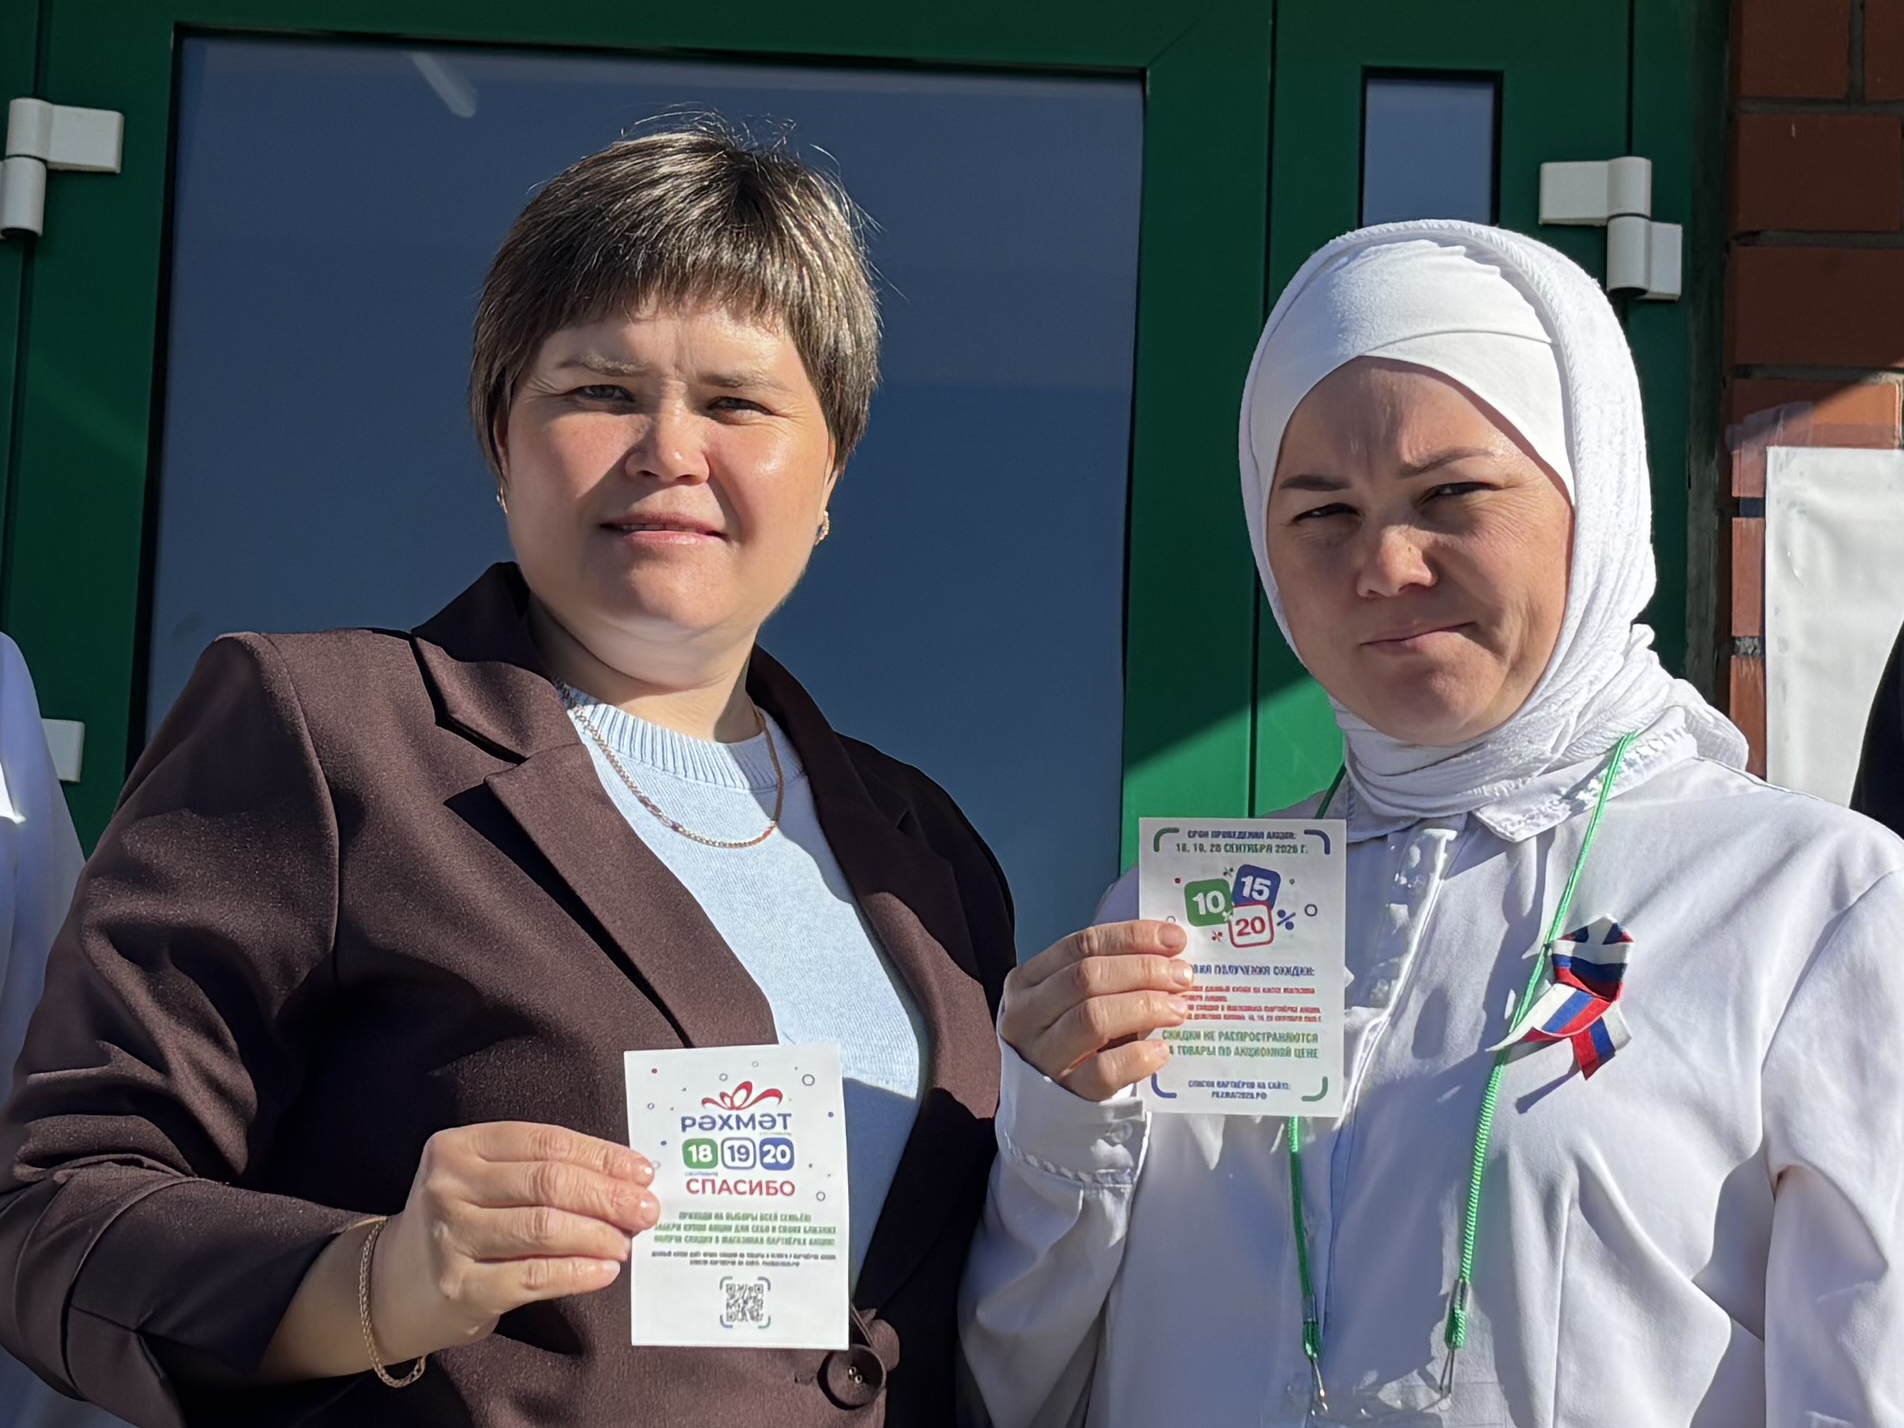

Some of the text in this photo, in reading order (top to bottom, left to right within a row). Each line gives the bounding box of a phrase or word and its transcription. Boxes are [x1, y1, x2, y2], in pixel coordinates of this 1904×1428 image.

[1240, 875, 1272, 901] 15
[1192, 890, 1225, 915] 10
[1235, 916, 1266, 937] 20
[680, 1113, 792, 1132] РӘХМӘТ
[688, 1143, 791, 1164] 18 19 20
[685, 1178, 796, 1196] СПАСИБО
